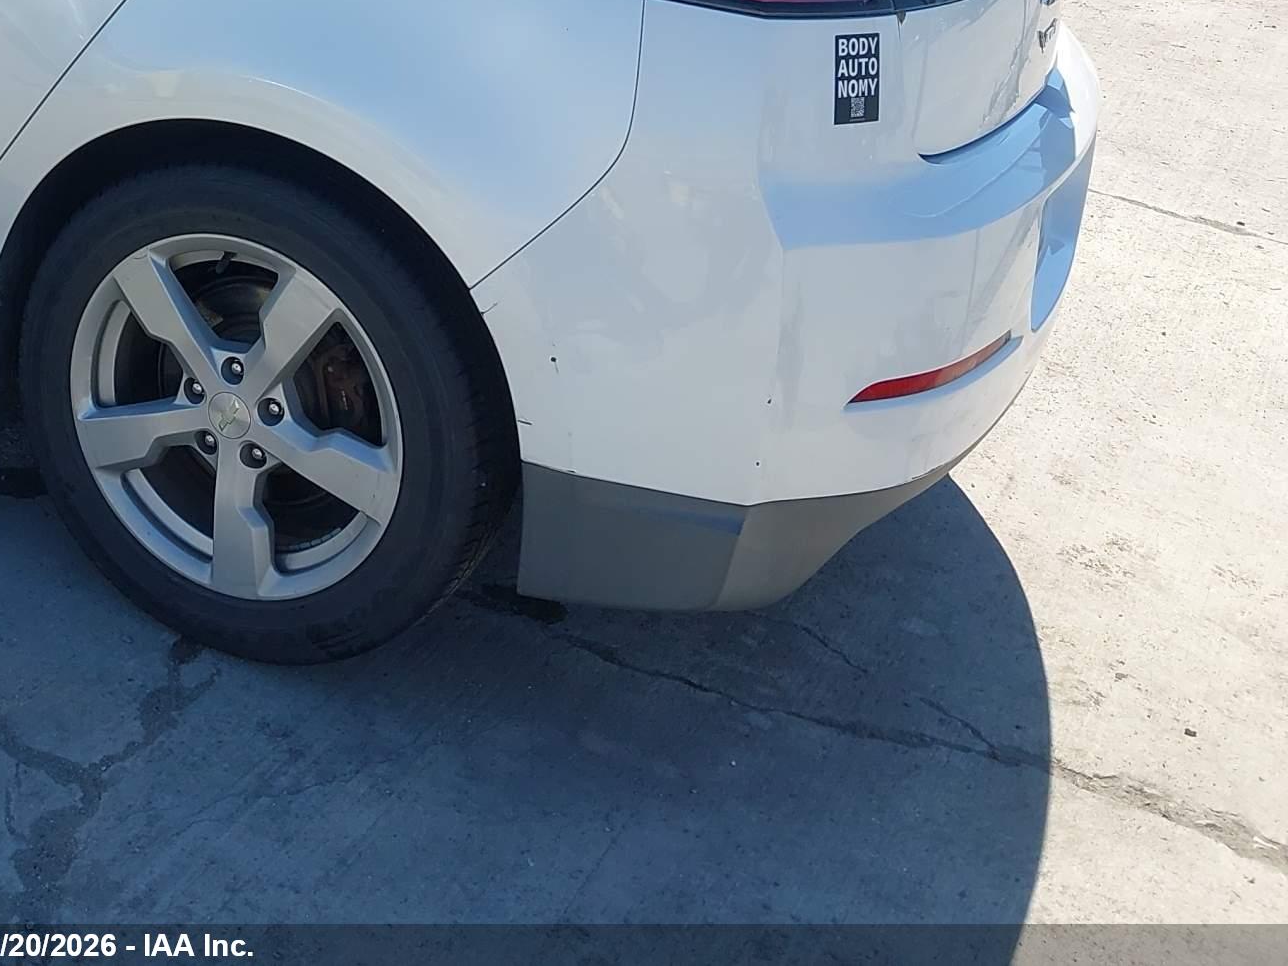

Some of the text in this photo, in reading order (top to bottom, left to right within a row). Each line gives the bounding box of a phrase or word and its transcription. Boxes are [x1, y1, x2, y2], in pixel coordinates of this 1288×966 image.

[838, 36, 878, 56] BODY
[837, 57, 878, 77] AUTO
[837, 77, 878, 99] NOMY
